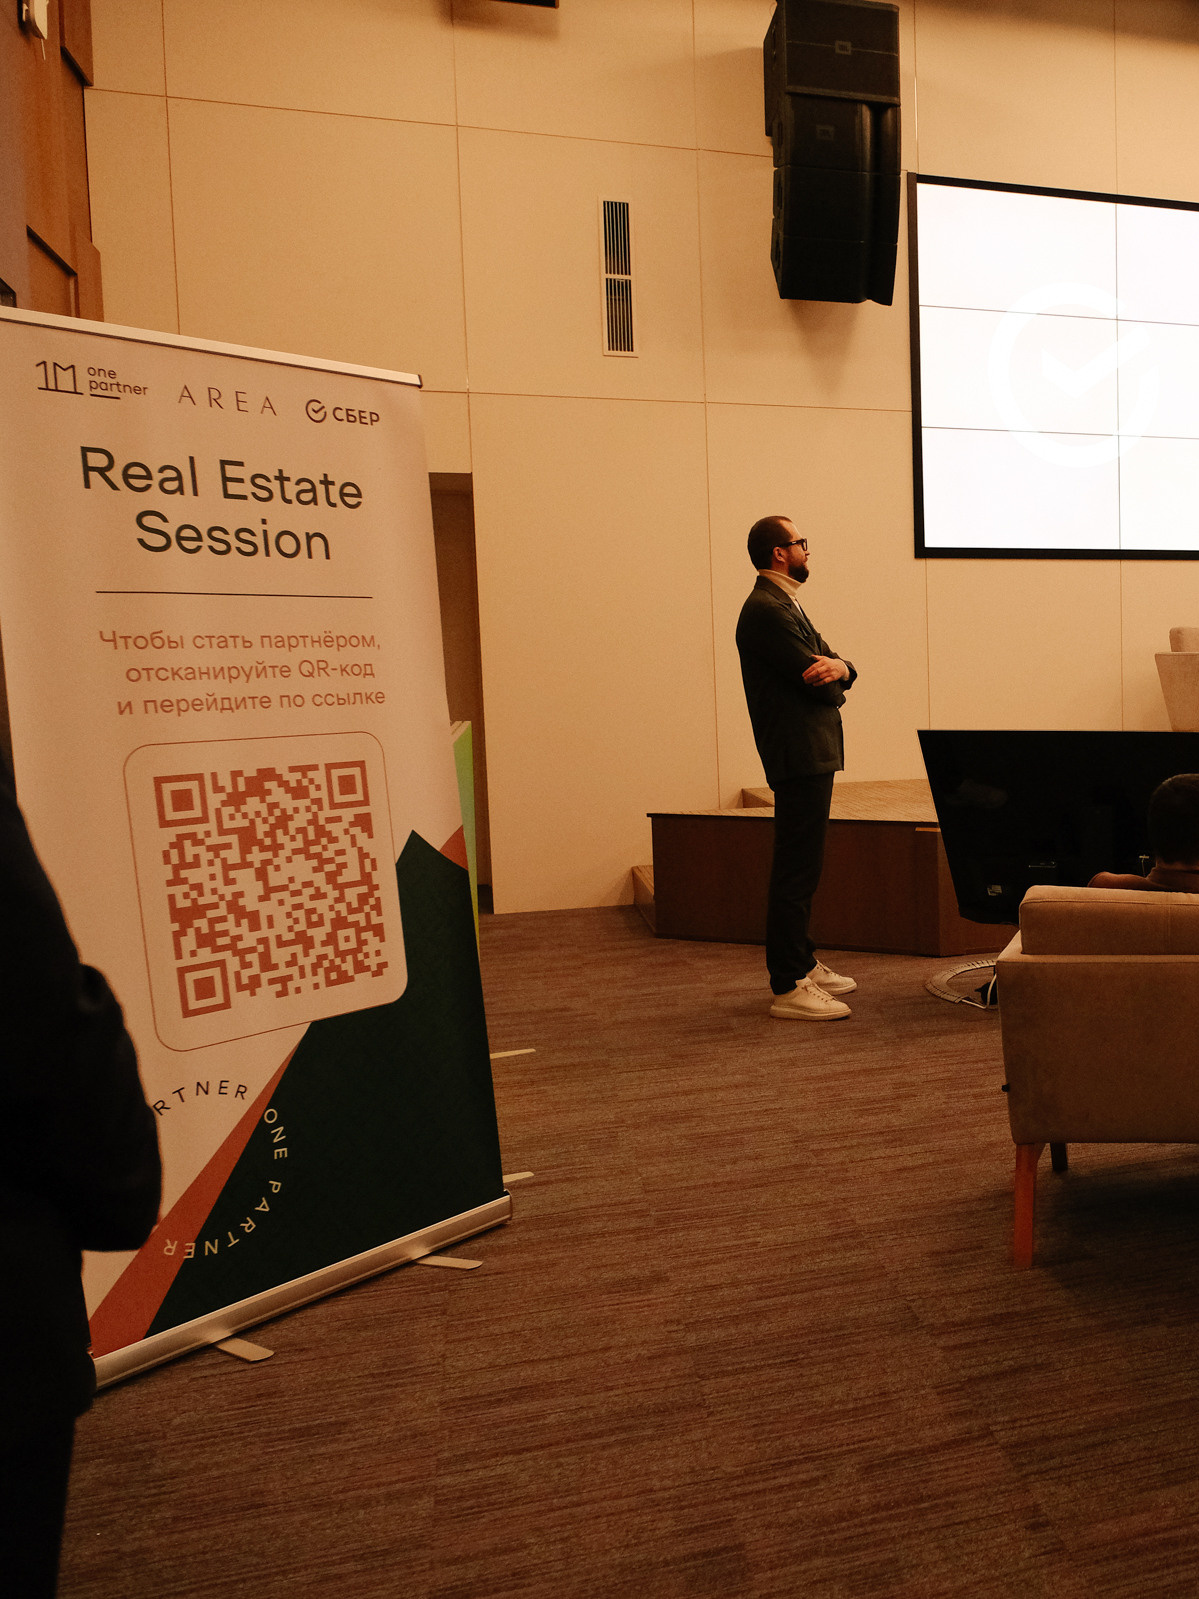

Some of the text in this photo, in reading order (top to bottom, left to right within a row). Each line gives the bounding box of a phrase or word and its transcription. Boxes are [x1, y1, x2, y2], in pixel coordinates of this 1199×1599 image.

[87, 366, 117, 379] one
[89, 379, 148, 396] partner
[178, 384, 277, 416] AREA
[332, 406, 380, 426] СБЕР
[80, 445, 363, 509] Real Estate
[136, 510, 331, 560] Session
[99, 630, 381, 652] Чтобы стать партнёром,
[125, 658, 376, 685] отсканируйте QR-код
[117, 690, 386, 717] и перейдите по ссылке
[152, 1080, 248, 1116] RTNER
[163, 1108, 288, 1259] ONE PARTNER
